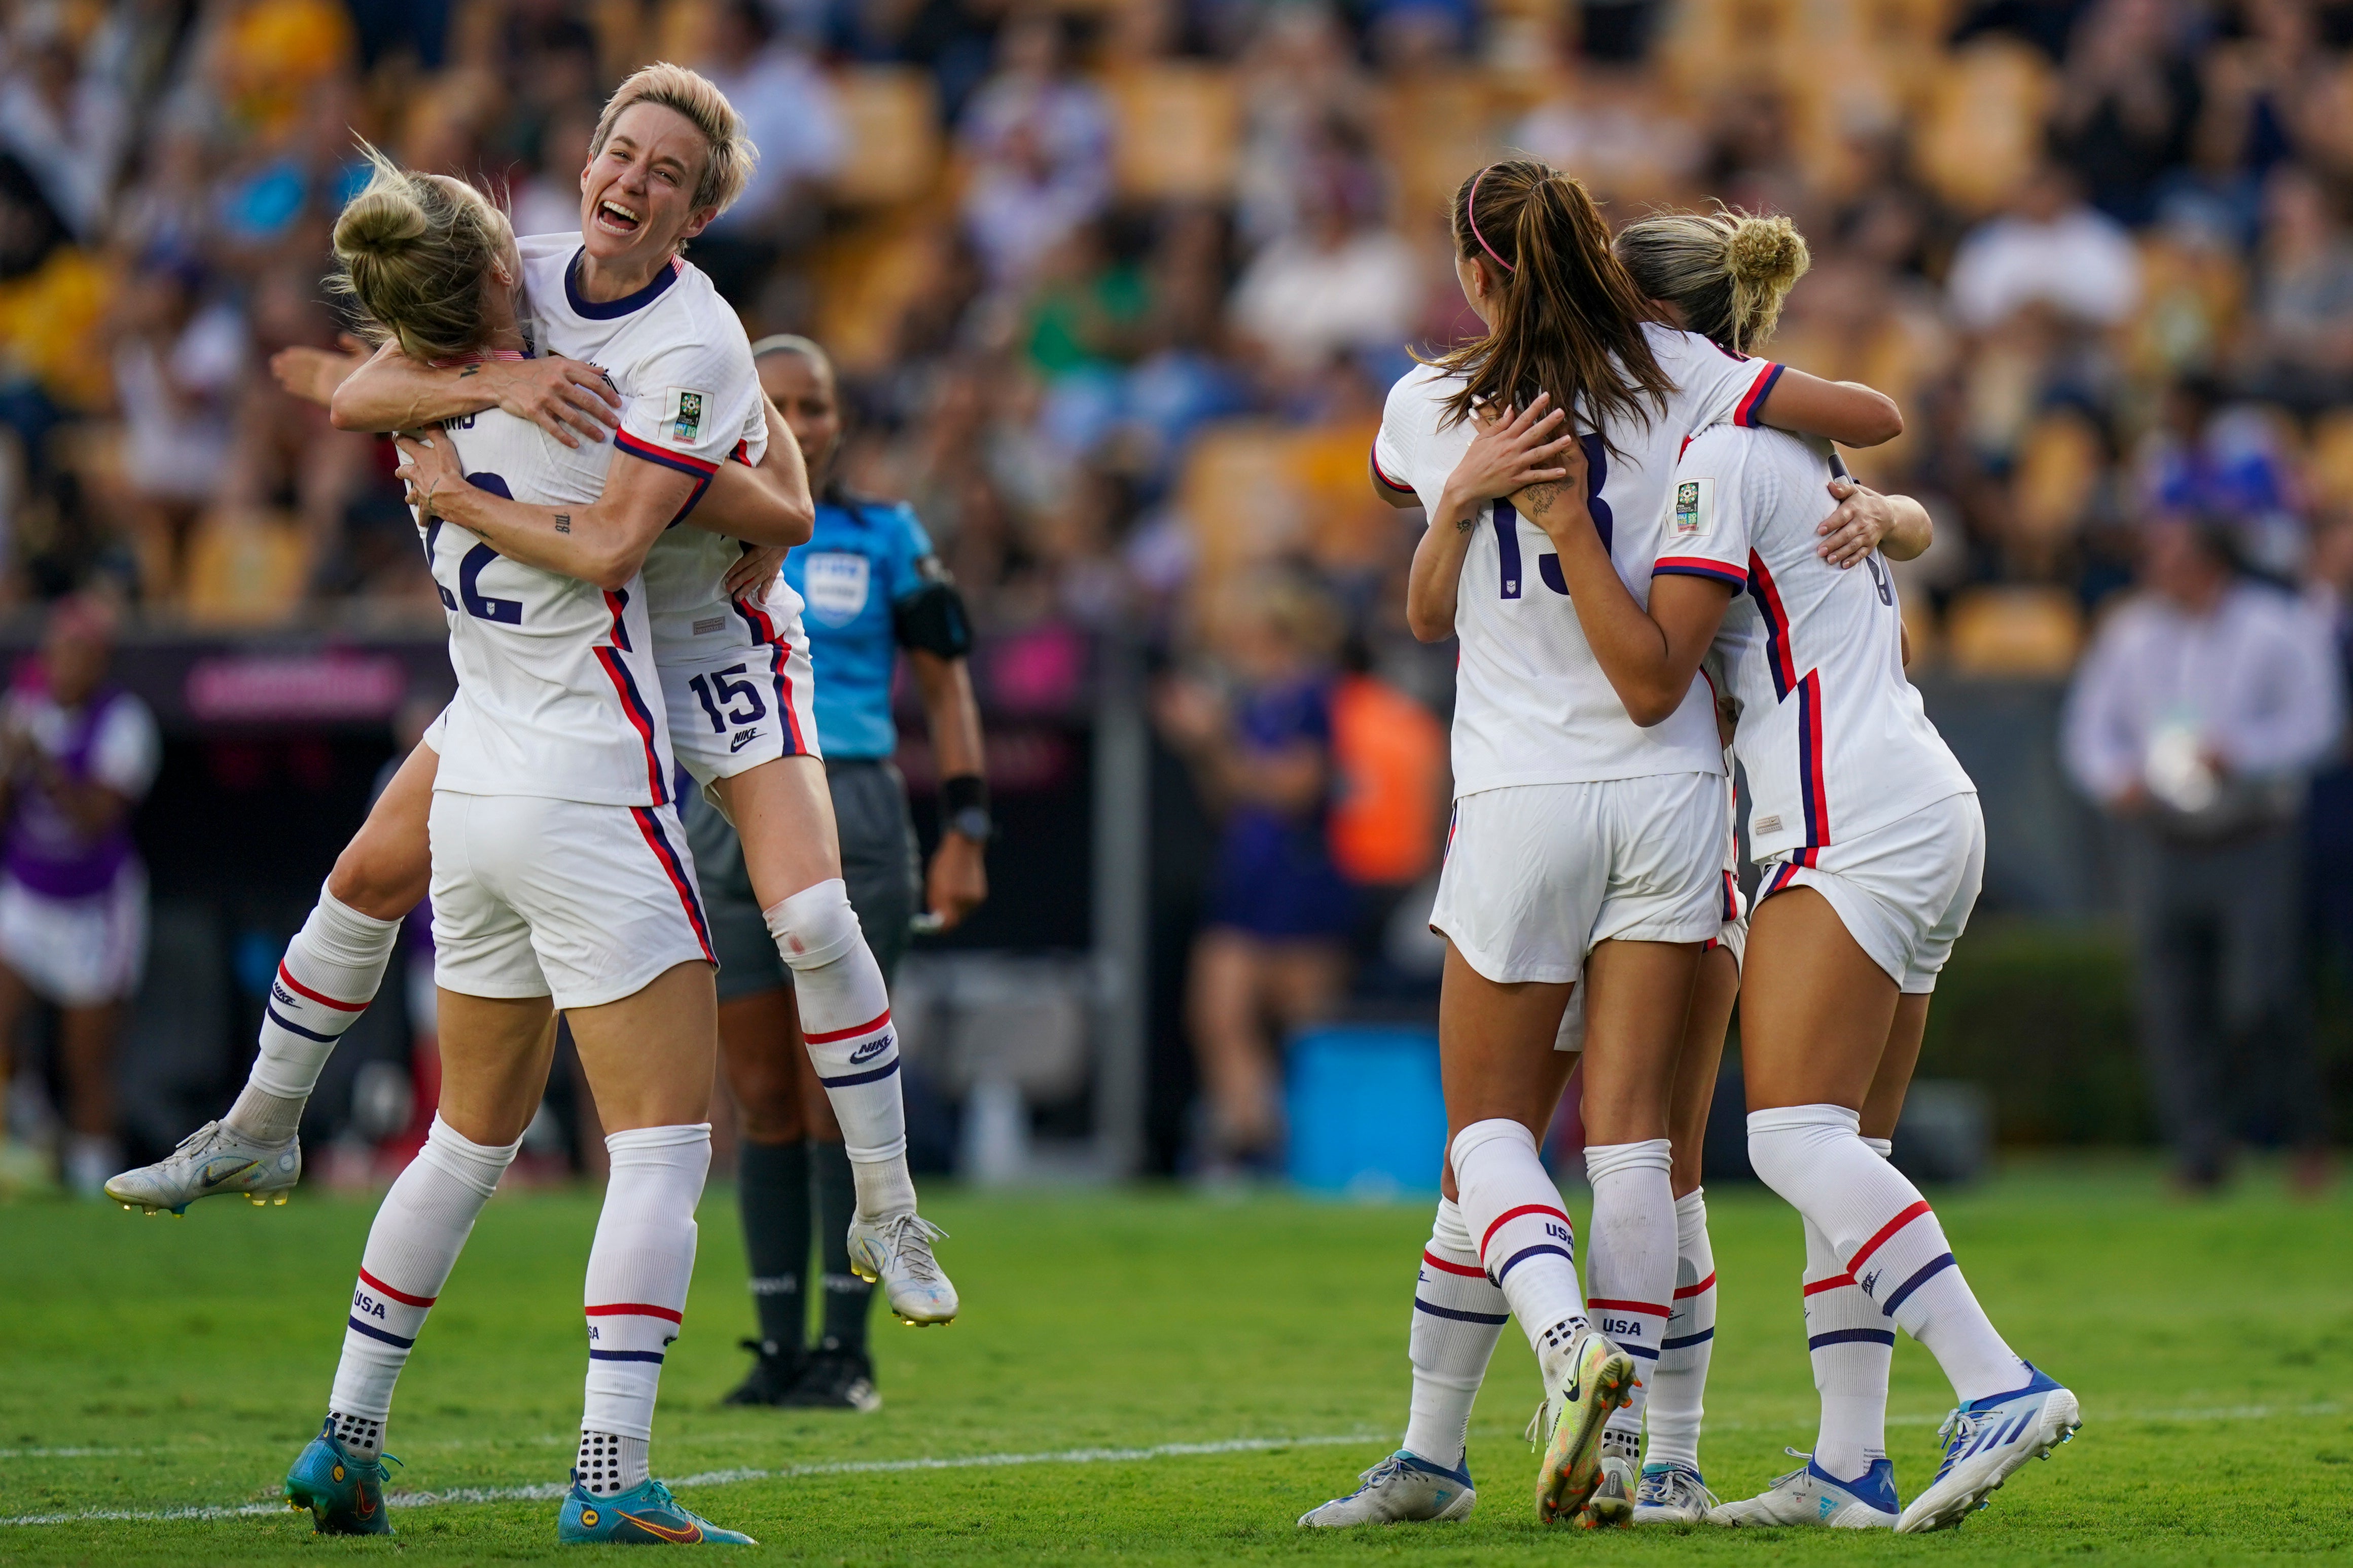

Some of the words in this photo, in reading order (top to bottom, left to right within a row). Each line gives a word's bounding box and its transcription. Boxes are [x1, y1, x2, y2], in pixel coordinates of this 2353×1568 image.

[689, 663, 766, 734] 15
[733, 727, 757, 744] NIKE
[274, 981, 296, 1003] NIKE
[858, 1035, 889, 1054] NIKE
[354, 1289, 385, 1319] USA
[1603, 1318, 1641, 1336] USA
